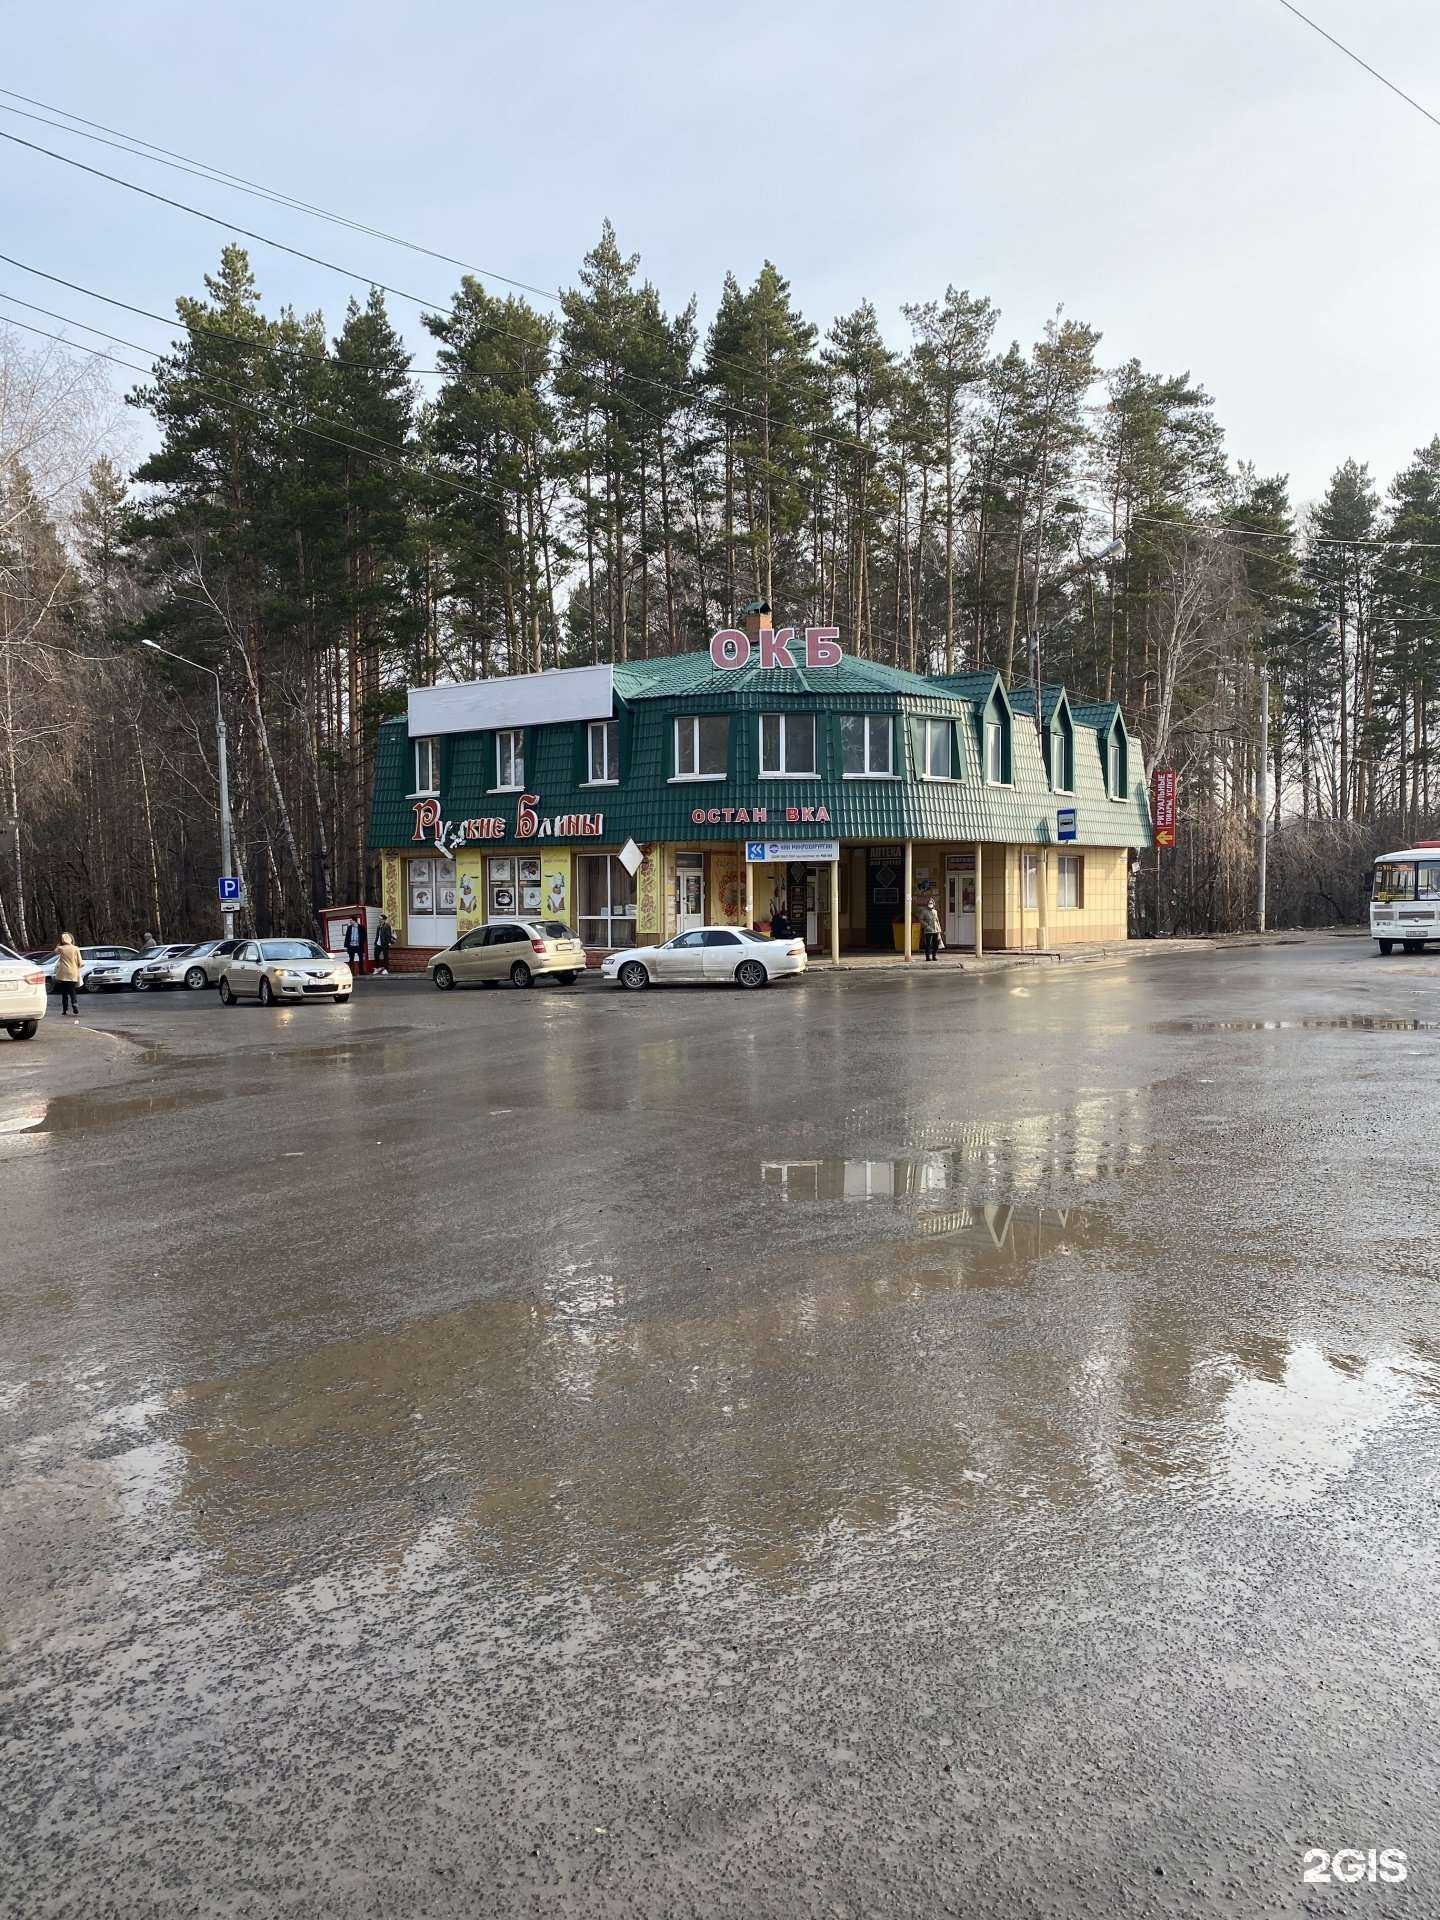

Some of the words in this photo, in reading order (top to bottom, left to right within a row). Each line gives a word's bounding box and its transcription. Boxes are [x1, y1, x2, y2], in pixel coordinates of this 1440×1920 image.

[710, 627, 842, 670] ОКБ
[1157, 773, 1166, 826] РИТУАЛЬНЫЕ
[870, 846, 902, 858] АПТЕКА
[224, 880, 236, 897] P
